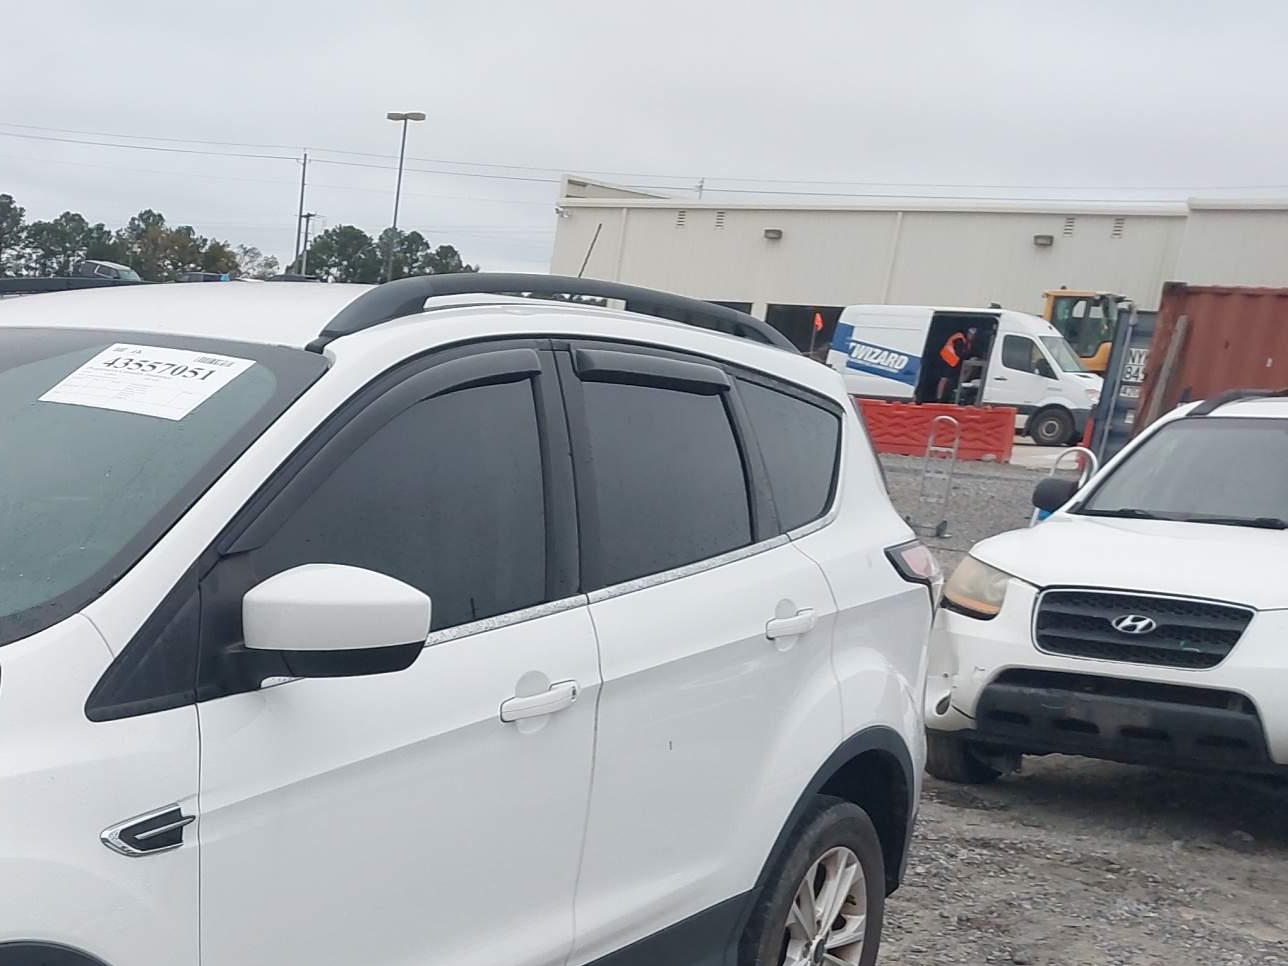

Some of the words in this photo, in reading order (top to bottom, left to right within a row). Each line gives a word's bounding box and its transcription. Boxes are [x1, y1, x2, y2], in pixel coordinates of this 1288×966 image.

[103, 356, 216, 381] 43557051
[848, 342, 909, 370] WIZARD
[1128, 349, 1148, 365] NY
